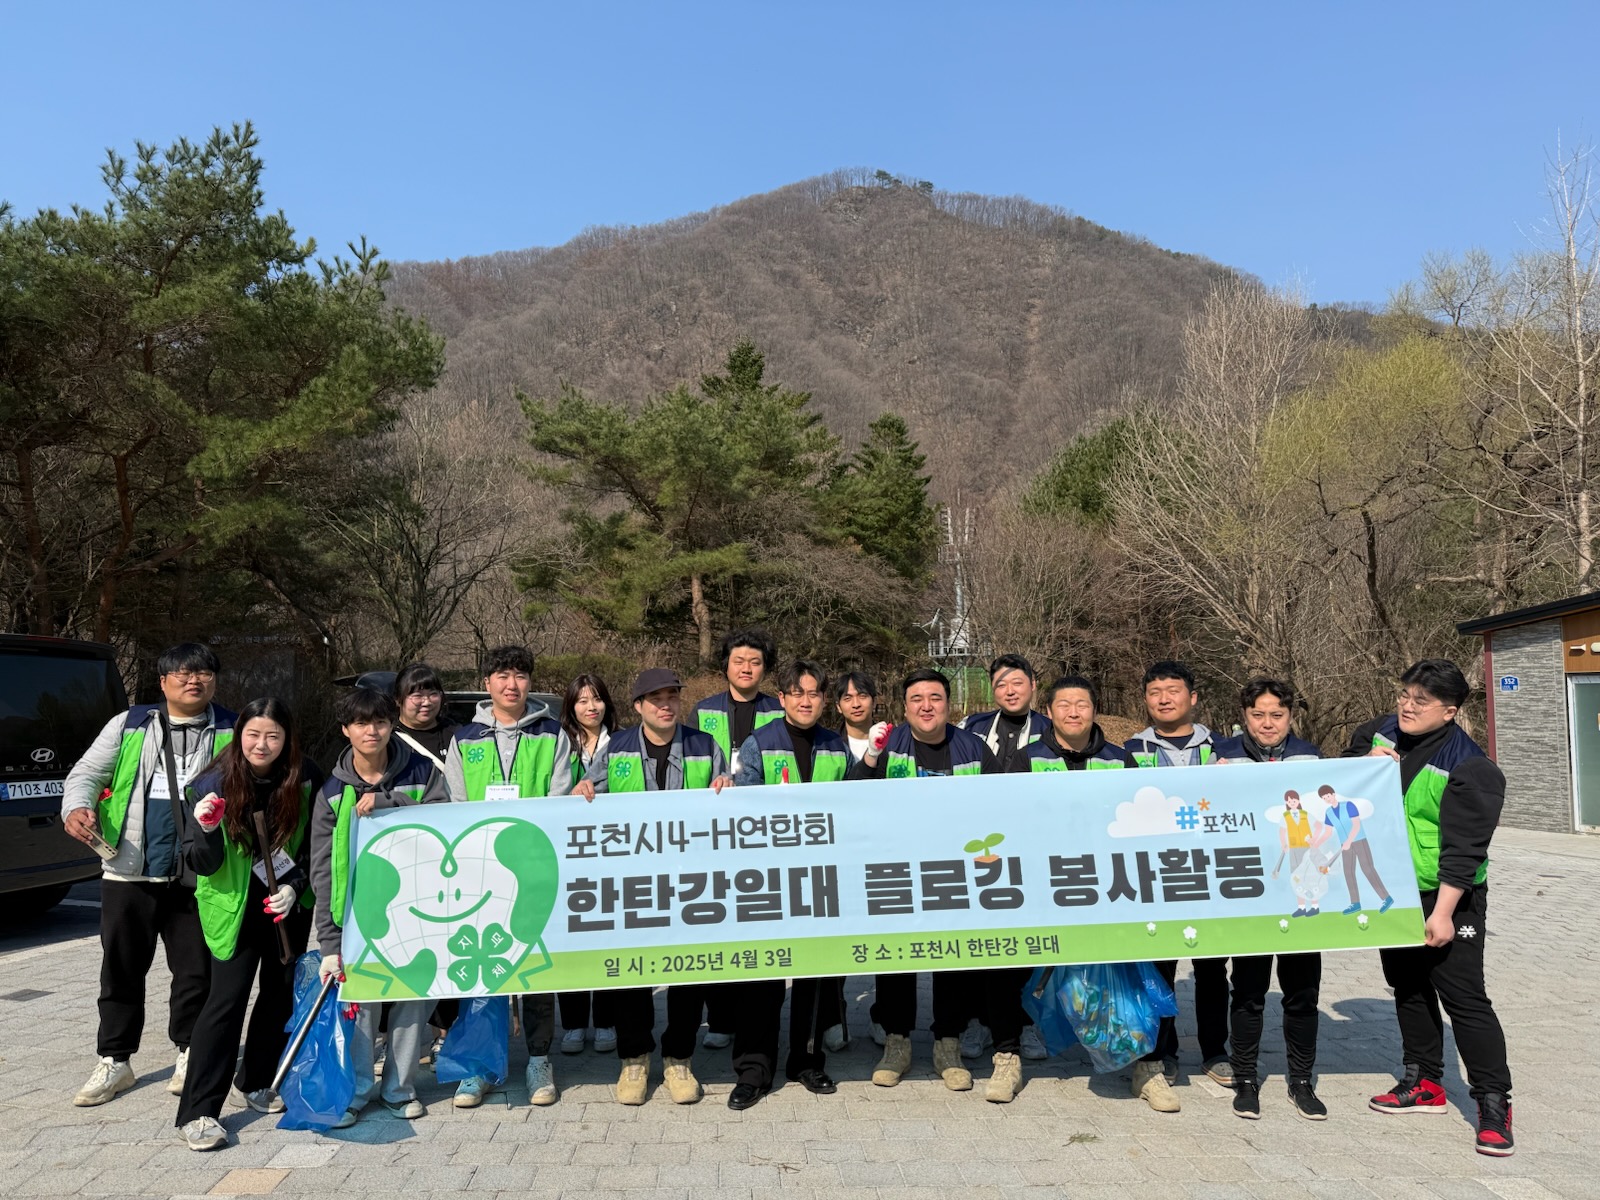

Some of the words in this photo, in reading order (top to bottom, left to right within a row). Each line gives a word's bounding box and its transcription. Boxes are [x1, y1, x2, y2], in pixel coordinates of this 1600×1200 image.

[9, 783, 42, 797] 710조
[44, 782, 64, 795] 403
[565, 812, 835, 859] 포천시4-H연합회
[566, 864, 840, 933] 한탄강일대
[864, 856, 1025, 916] 플로깅
[1048, 846, 1265, 907] 봉사활동
[457, 935, 473, 950] 지
[909, 939, 961, 960] 포천시
[966, 936, 1019, 958] 한탄강
[1024, 934, 1060, 955] 일대
[492, 963, 507, 978] 체
[662, 951, 724, 973] 2025년
[730, 949, 758, 969] 4월
[764, 947, 793, 968] 3일
